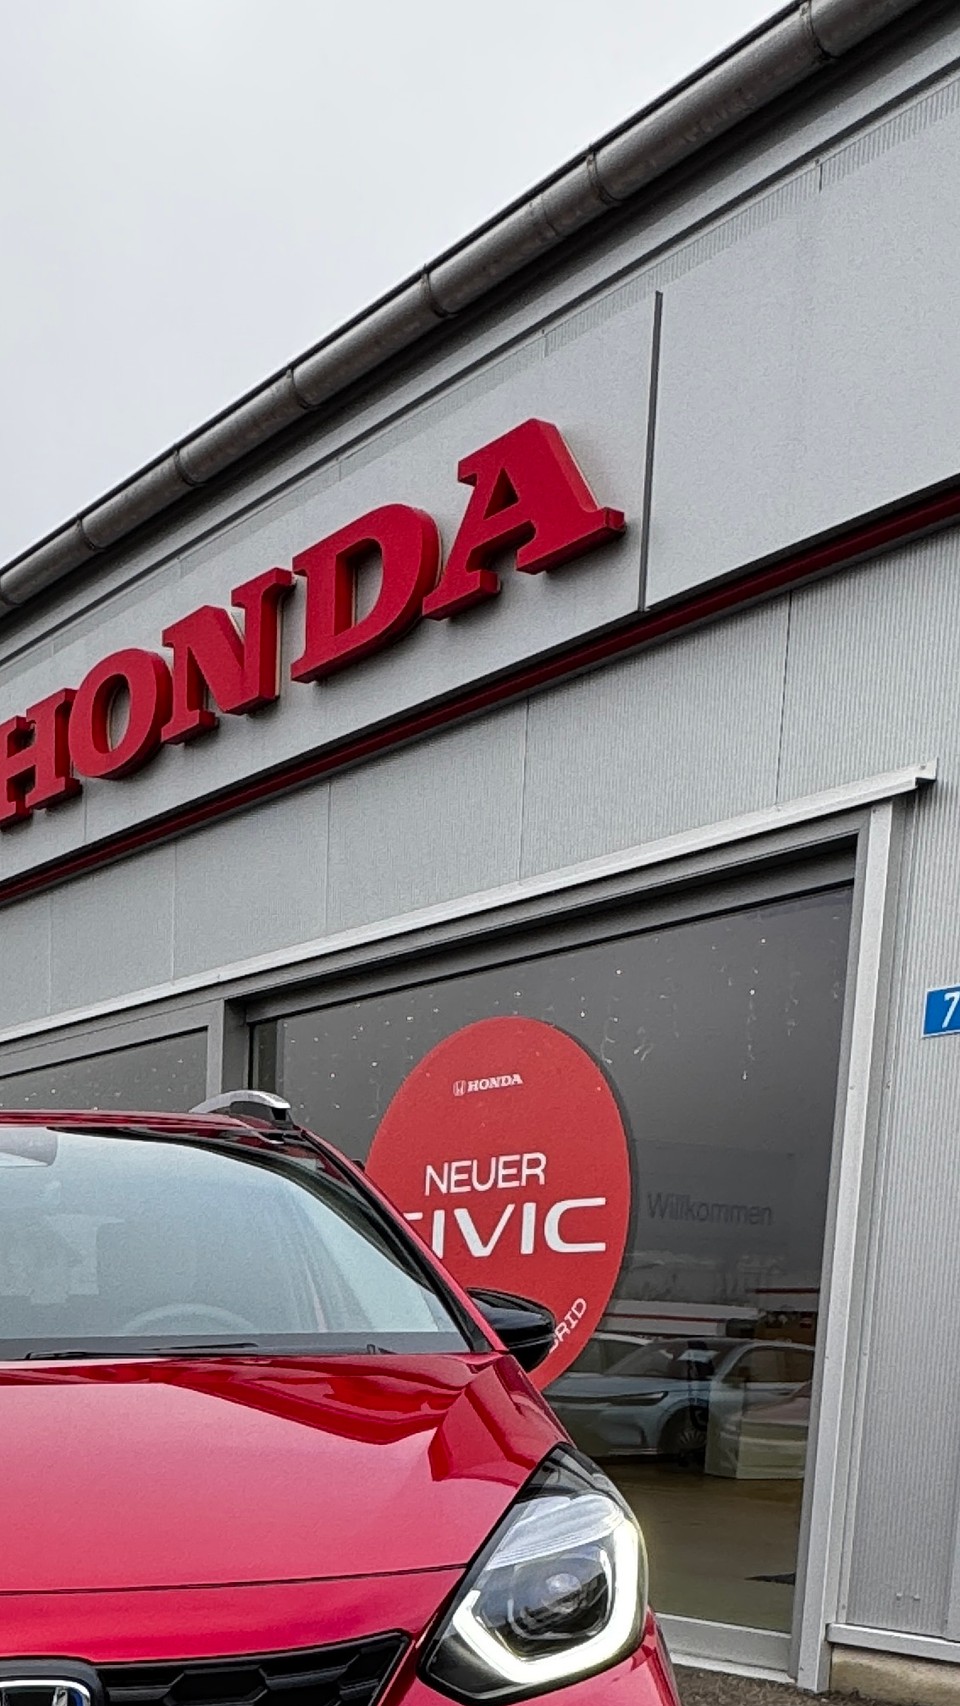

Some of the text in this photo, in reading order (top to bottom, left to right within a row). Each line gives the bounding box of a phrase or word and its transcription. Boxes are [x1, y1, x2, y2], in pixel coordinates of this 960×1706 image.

[467, 1073, 524, 1092] HONDA
[424, 1151, 547, 1196] NEUER
[403, 1197, 606, 1259] IVIC
[647, 1192, 772, 1226] Willkommen
